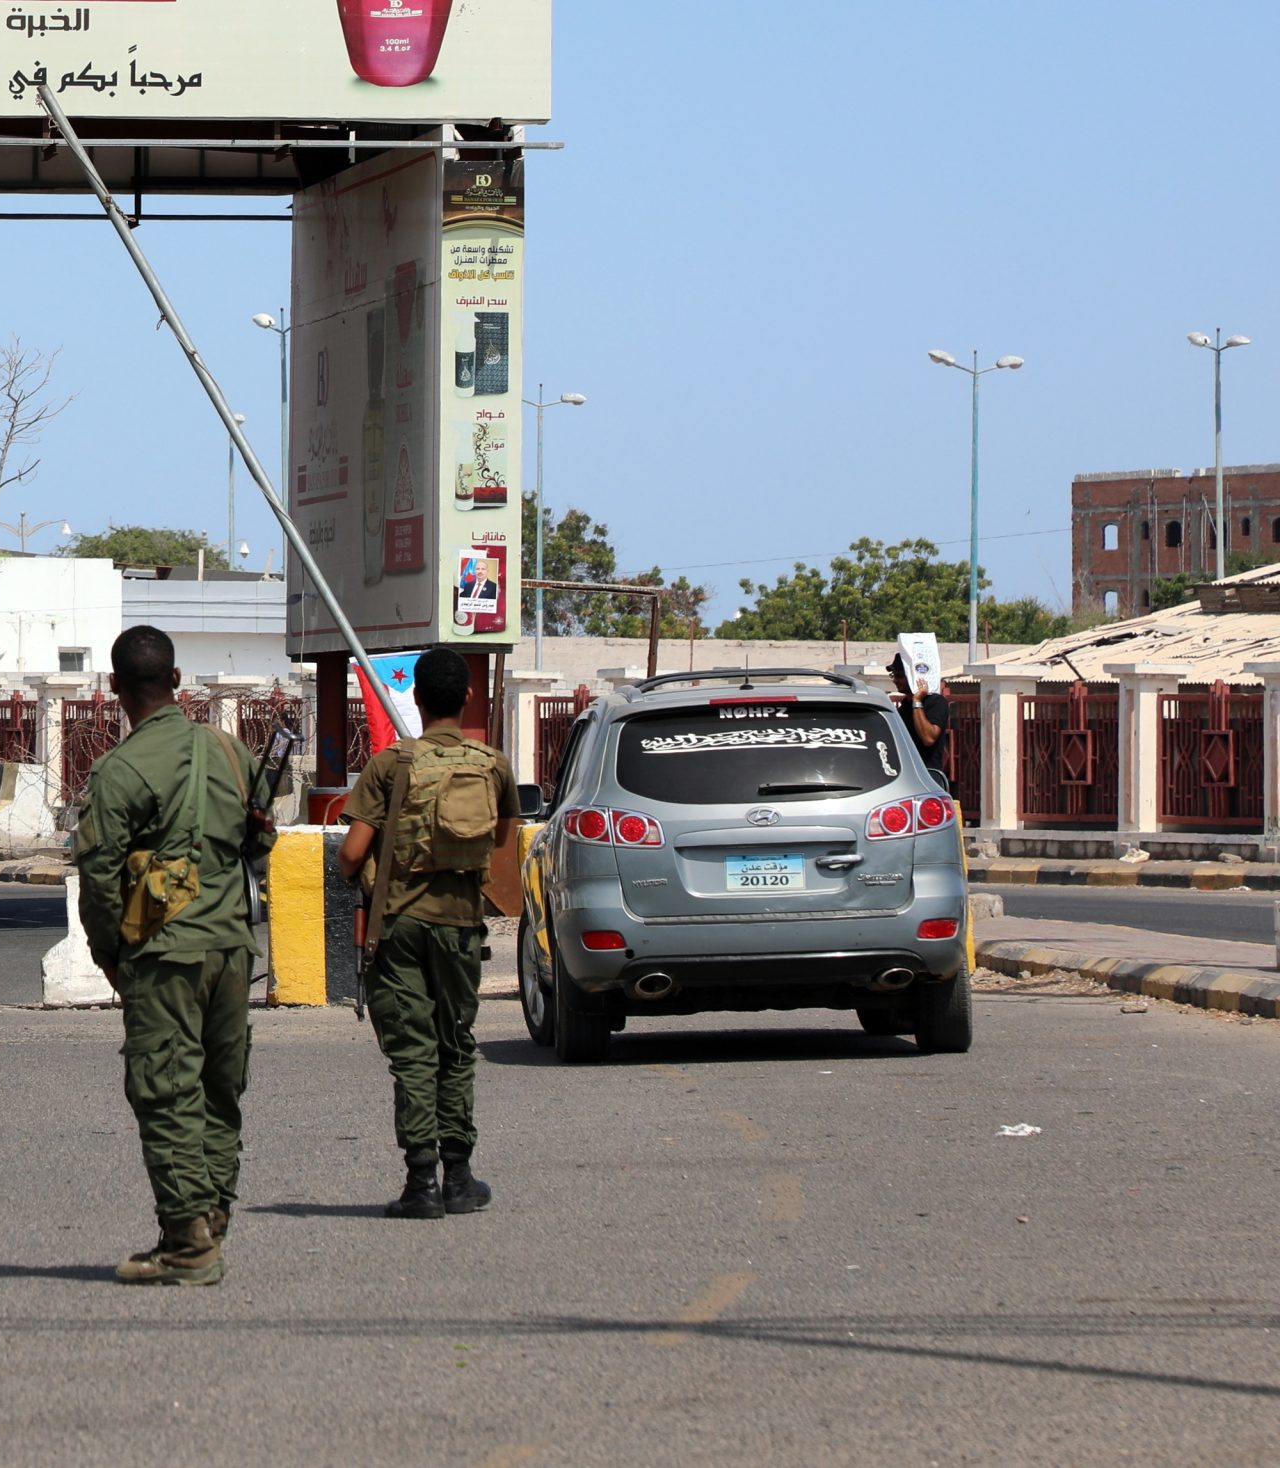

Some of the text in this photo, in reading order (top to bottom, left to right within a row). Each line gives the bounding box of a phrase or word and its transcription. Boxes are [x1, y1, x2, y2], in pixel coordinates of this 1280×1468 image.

[6, 7, 90, 38] الخبرة
[128, 44, 202, 97] مرحباً
[8, 60, 48, 100] في
[57, 61, 118, 98] بكم
[450, 245, 461, 254] من
[462, 245, 486, 256] واسعة
[479, 256, 508, 266] معطرات
[477, 270, 490, 282] كل
[487, 298, 508, 307] سحر
[741, 862, 788, 873] مؤقت عدن
[740, 875, 790, 887] 20120
